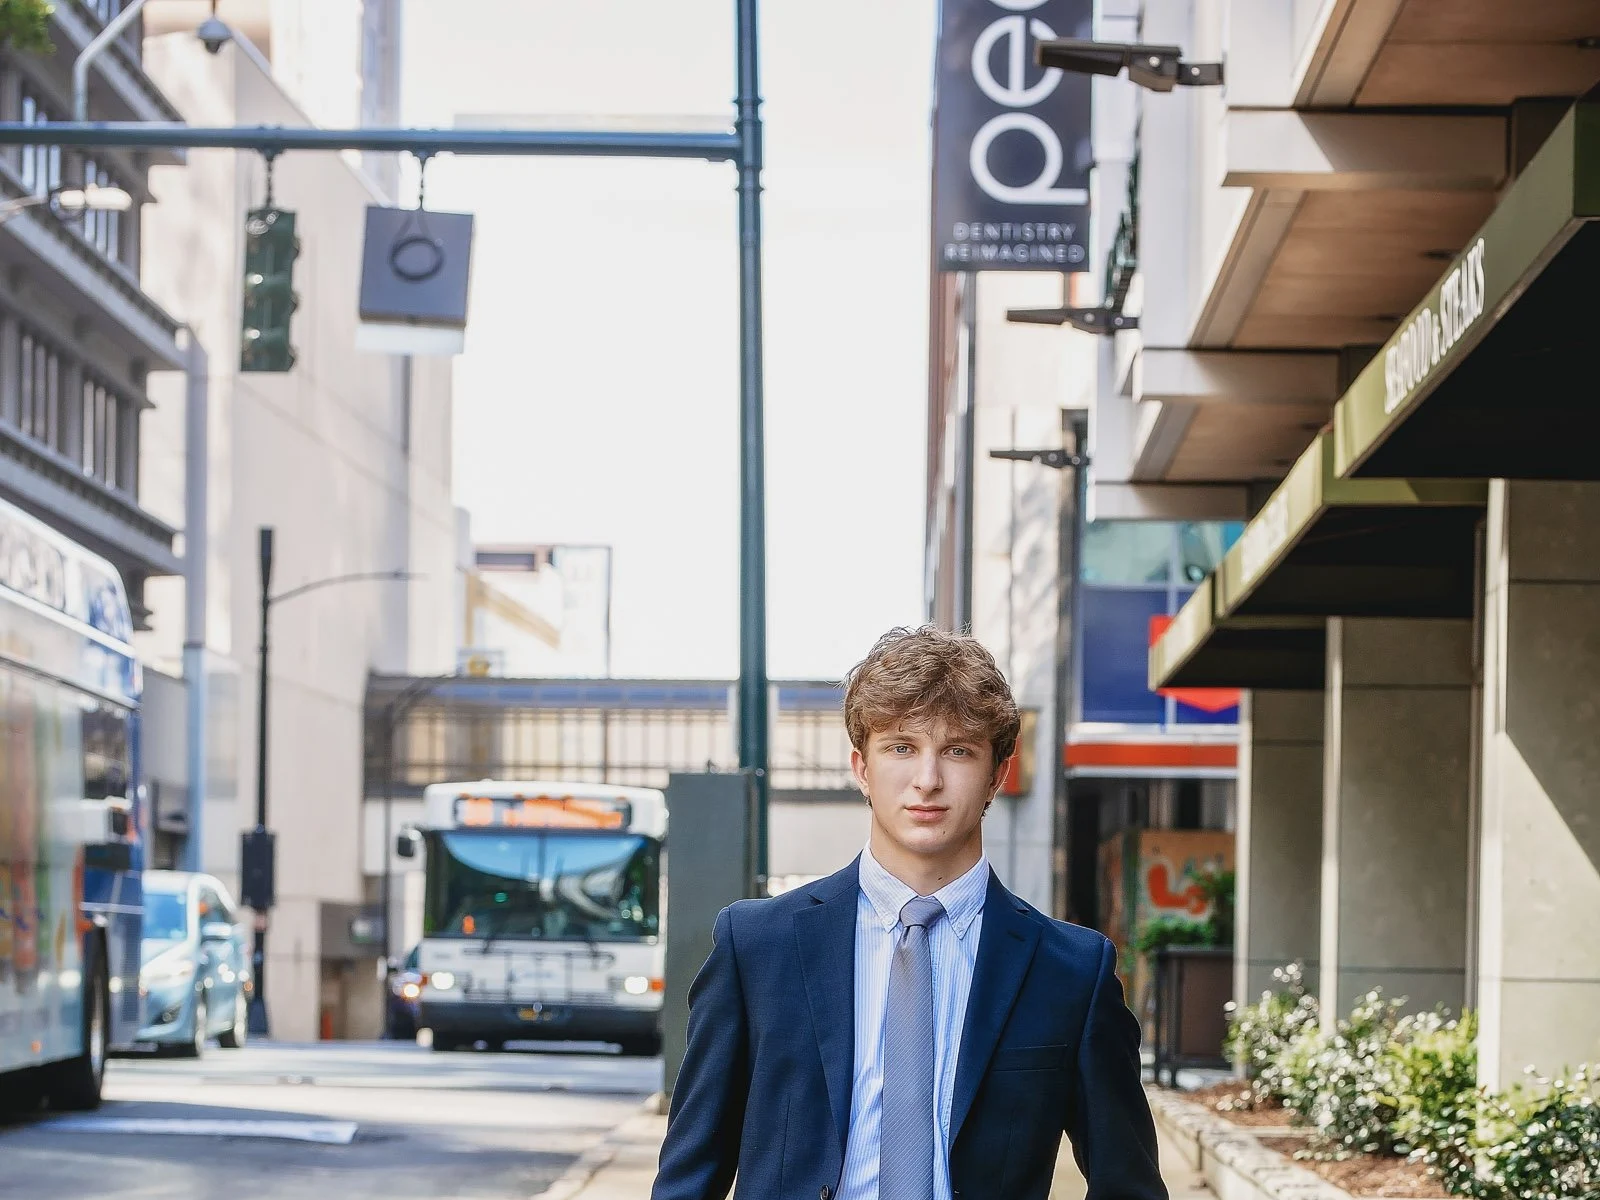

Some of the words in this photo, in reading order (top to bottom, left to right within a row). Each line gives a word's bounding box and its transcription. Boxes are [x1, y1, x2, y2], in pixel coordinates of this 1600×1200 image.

[969, 0, 1088, 205] pe
[944, 243, 1086, 263] REIMAGINED
[952, 222, 1077, 241] DENTISTRY
[1440, 237, 1485, 356] STEAKS
